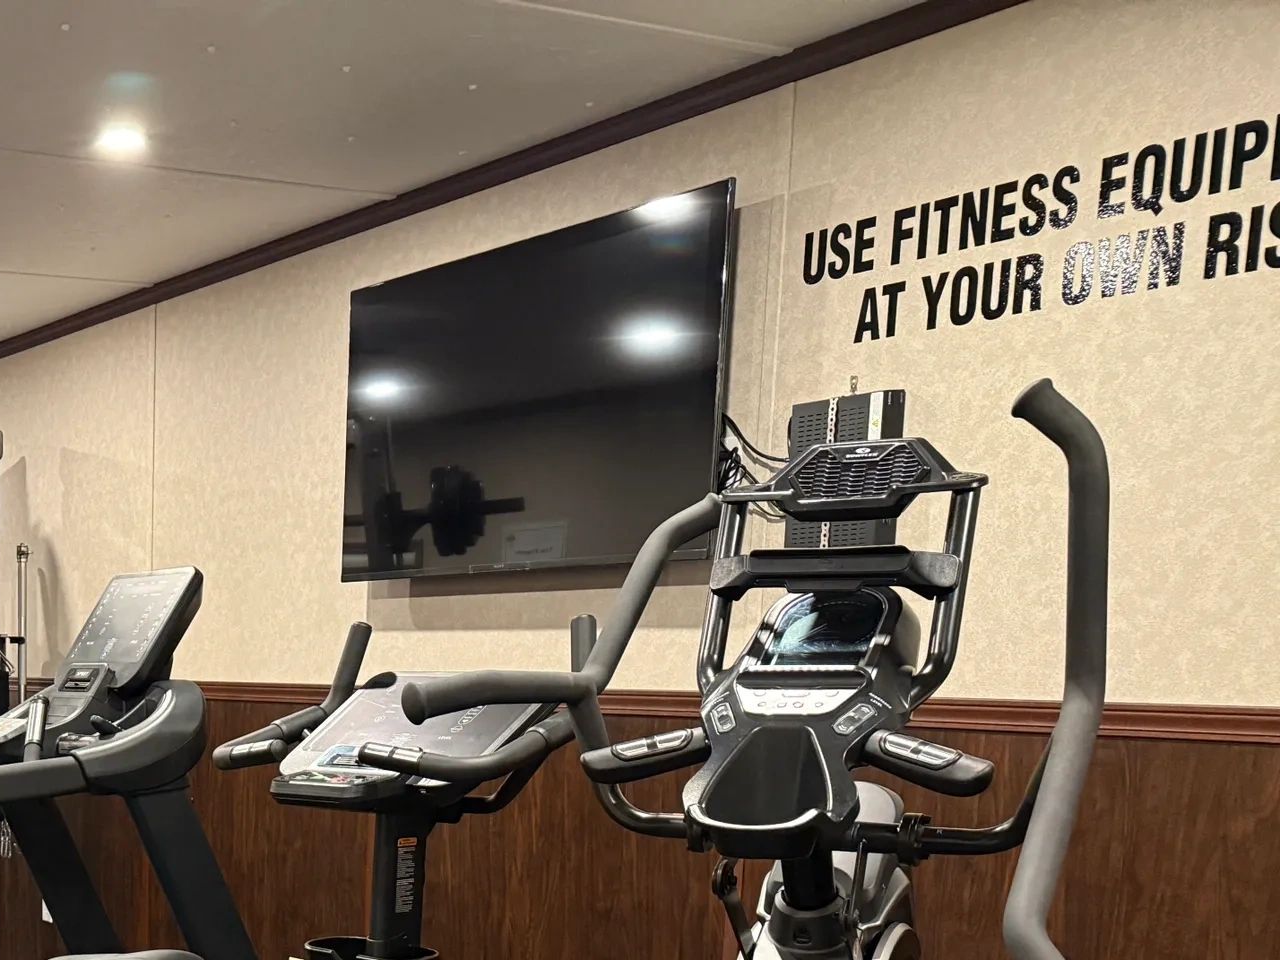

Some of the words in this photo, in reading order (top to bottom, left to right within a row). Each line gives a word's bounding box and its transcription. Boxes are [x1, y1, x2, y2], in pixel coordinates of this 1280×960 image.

[802, 216, 877, 285] USE
[890, 165, 1081, 266] FITNESS
[1097, 113, 1280, 220] EQUIP
[853, 280, 906, 344] AT
[921, 253, 1044, 331] YOUR
[1061, 221, 1186, 306] OWN
